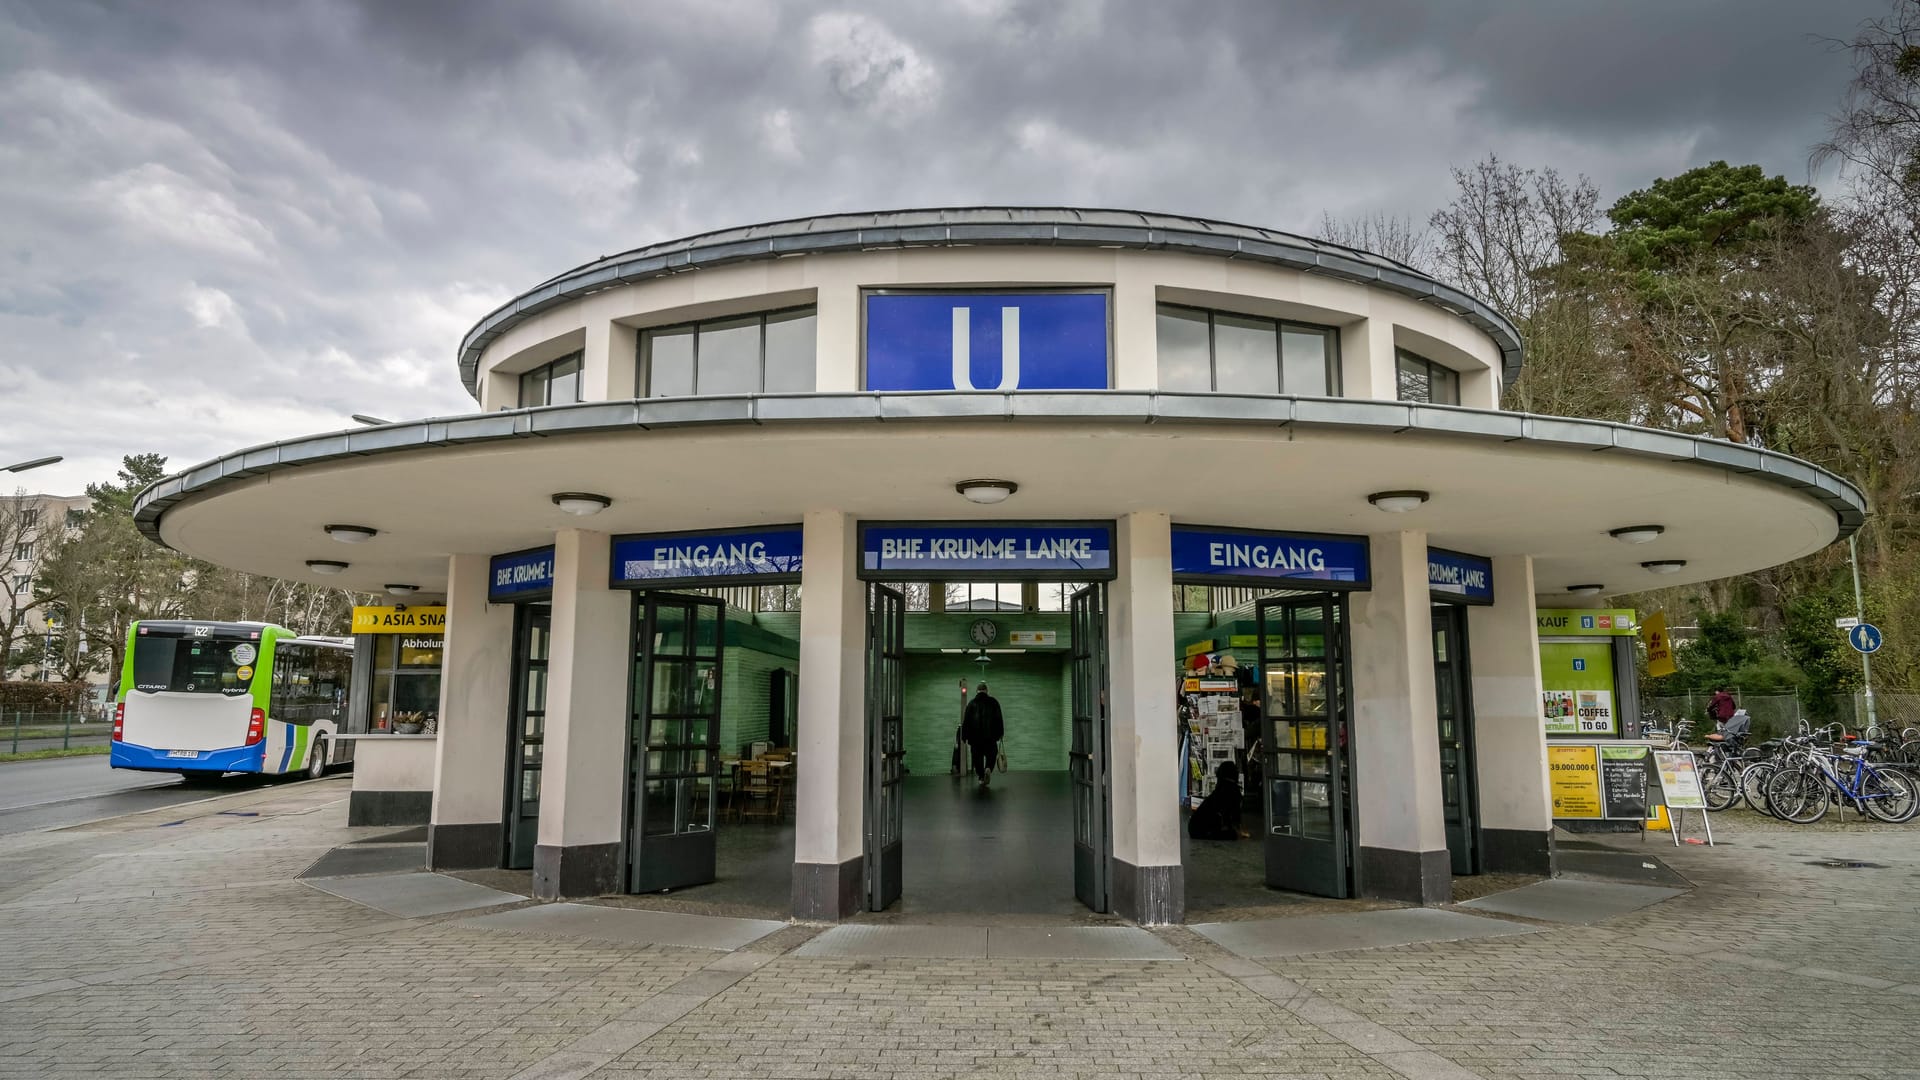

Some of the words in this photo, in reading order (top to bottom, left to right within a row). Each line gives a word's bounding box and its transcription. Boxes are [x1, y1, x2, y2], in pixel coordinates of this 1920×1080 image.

[952, 307, 1020, 391] U
[653, 541, 766, 570] EINGANG
[881, 538, 923, 559] BHF.
[930, 537, 1016, 559] KRUMME
[1026, 537, 1092, 559] LANKE
[1210, 542, 1325, 571] EINGANG
[497, 567, 512, 586] BHF.
[513, 561, 546, 583] KRUMME
[1460, 567, 1485, 589] LANKE
[383, 614, 415, 626] ASIA
[1537, 616, 1569, 628] KAUF
[1649, 650, 1667, 661] LOTTO
[1578, 708, 1609, 717] COFFEE
[1582, 722, 1593, 730] TO
[1595, 722, 1608, 730] GO
